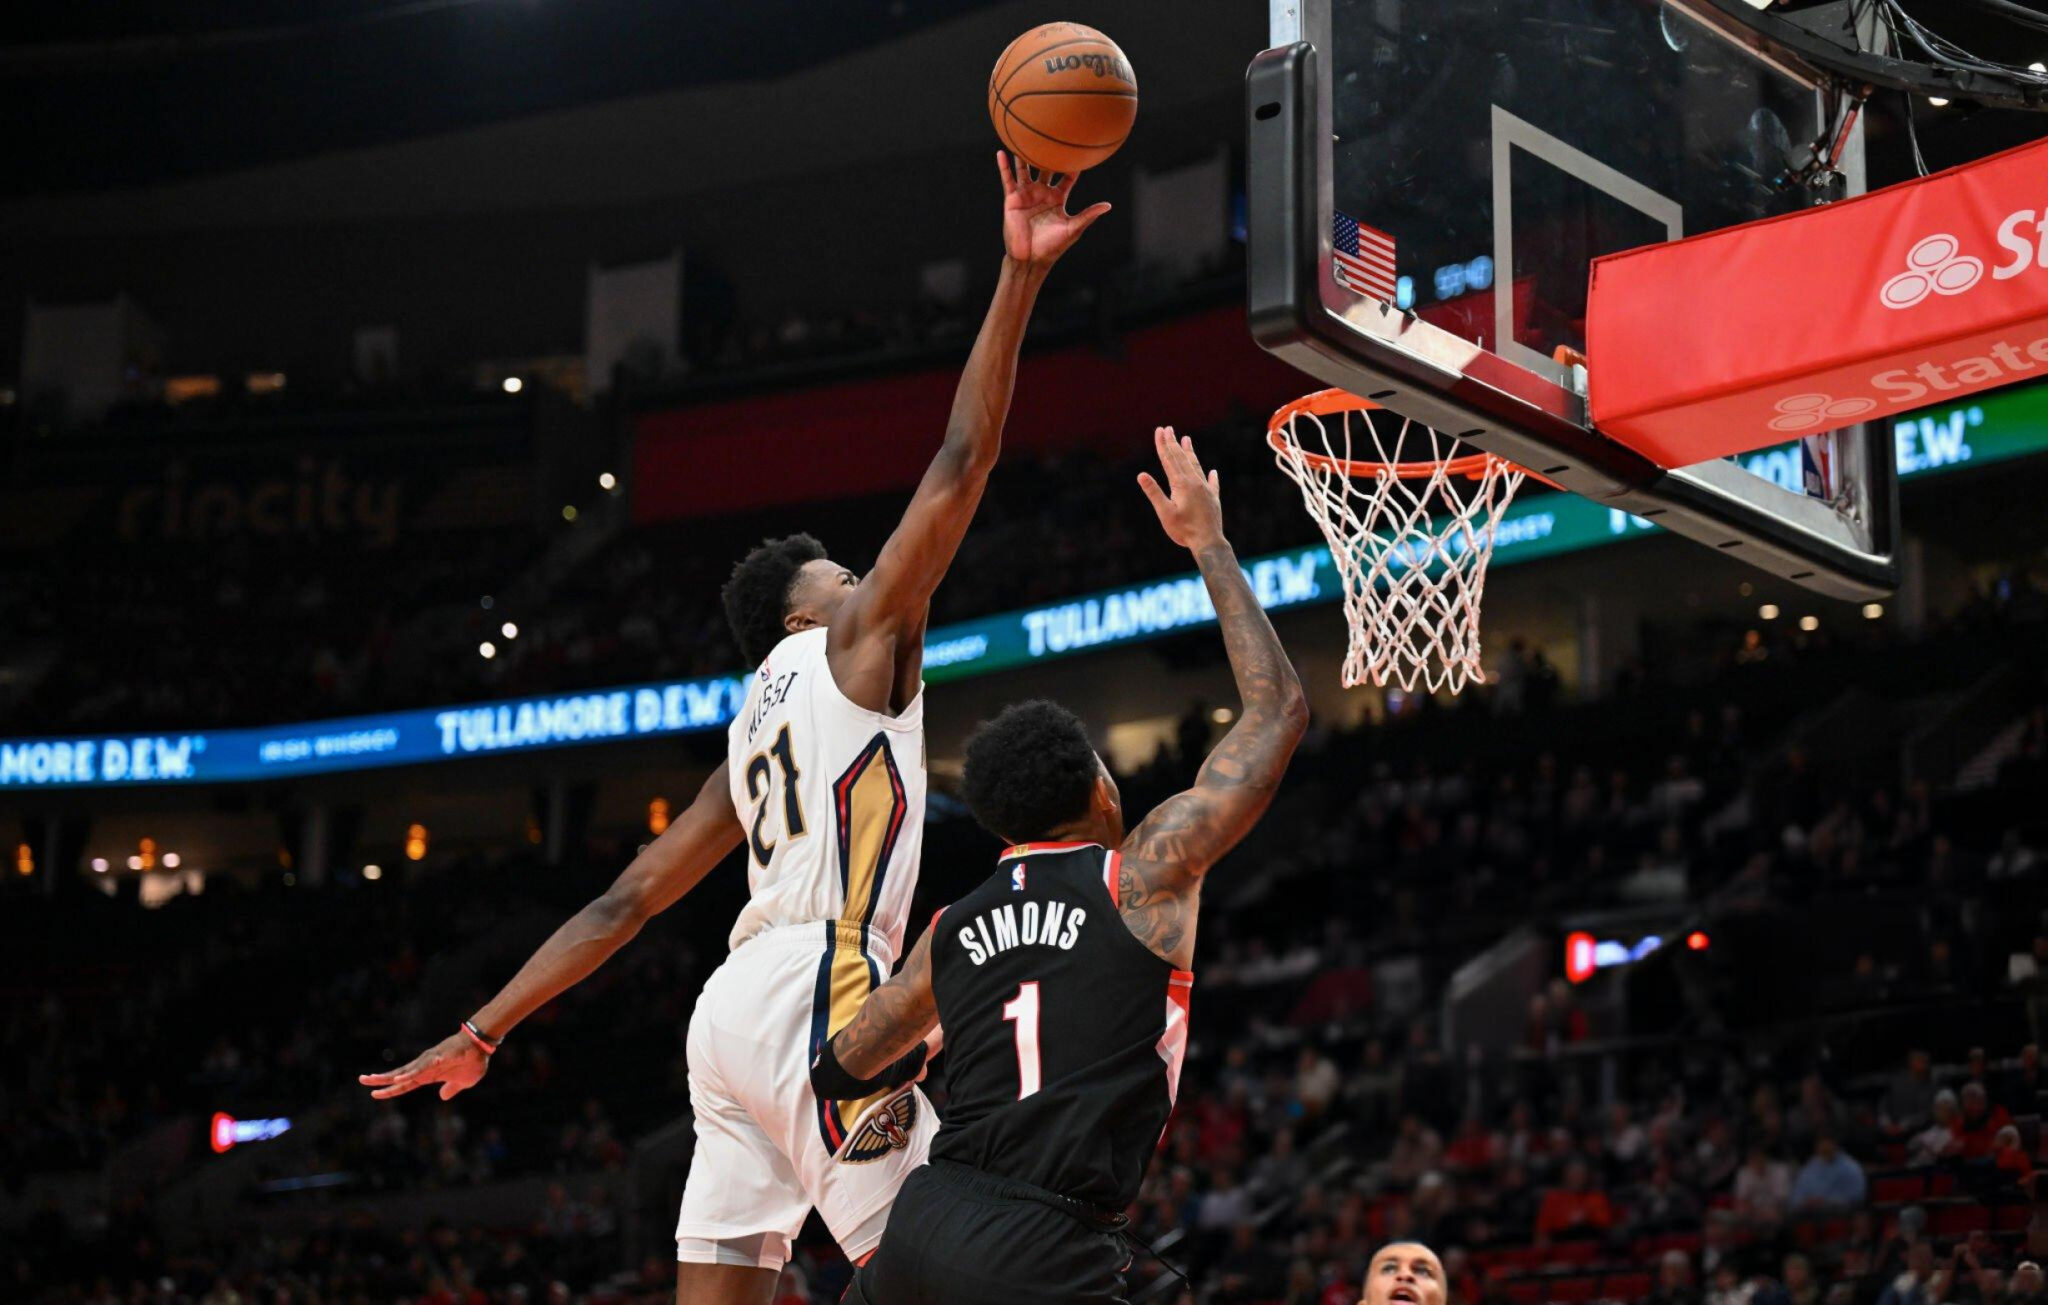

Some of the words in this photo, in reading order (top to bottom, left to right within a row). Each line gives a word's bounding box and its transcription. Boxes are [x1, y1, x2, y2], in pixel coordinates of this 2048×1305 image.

[436, 691, 632, 753] TULLAMORE
[748, 671, 799, 744] MISSI
[745, 721, 808, 870] 21
[958, 901, 1087, 966] SIMONS
[1002, 980, 1041, 1101] 1
